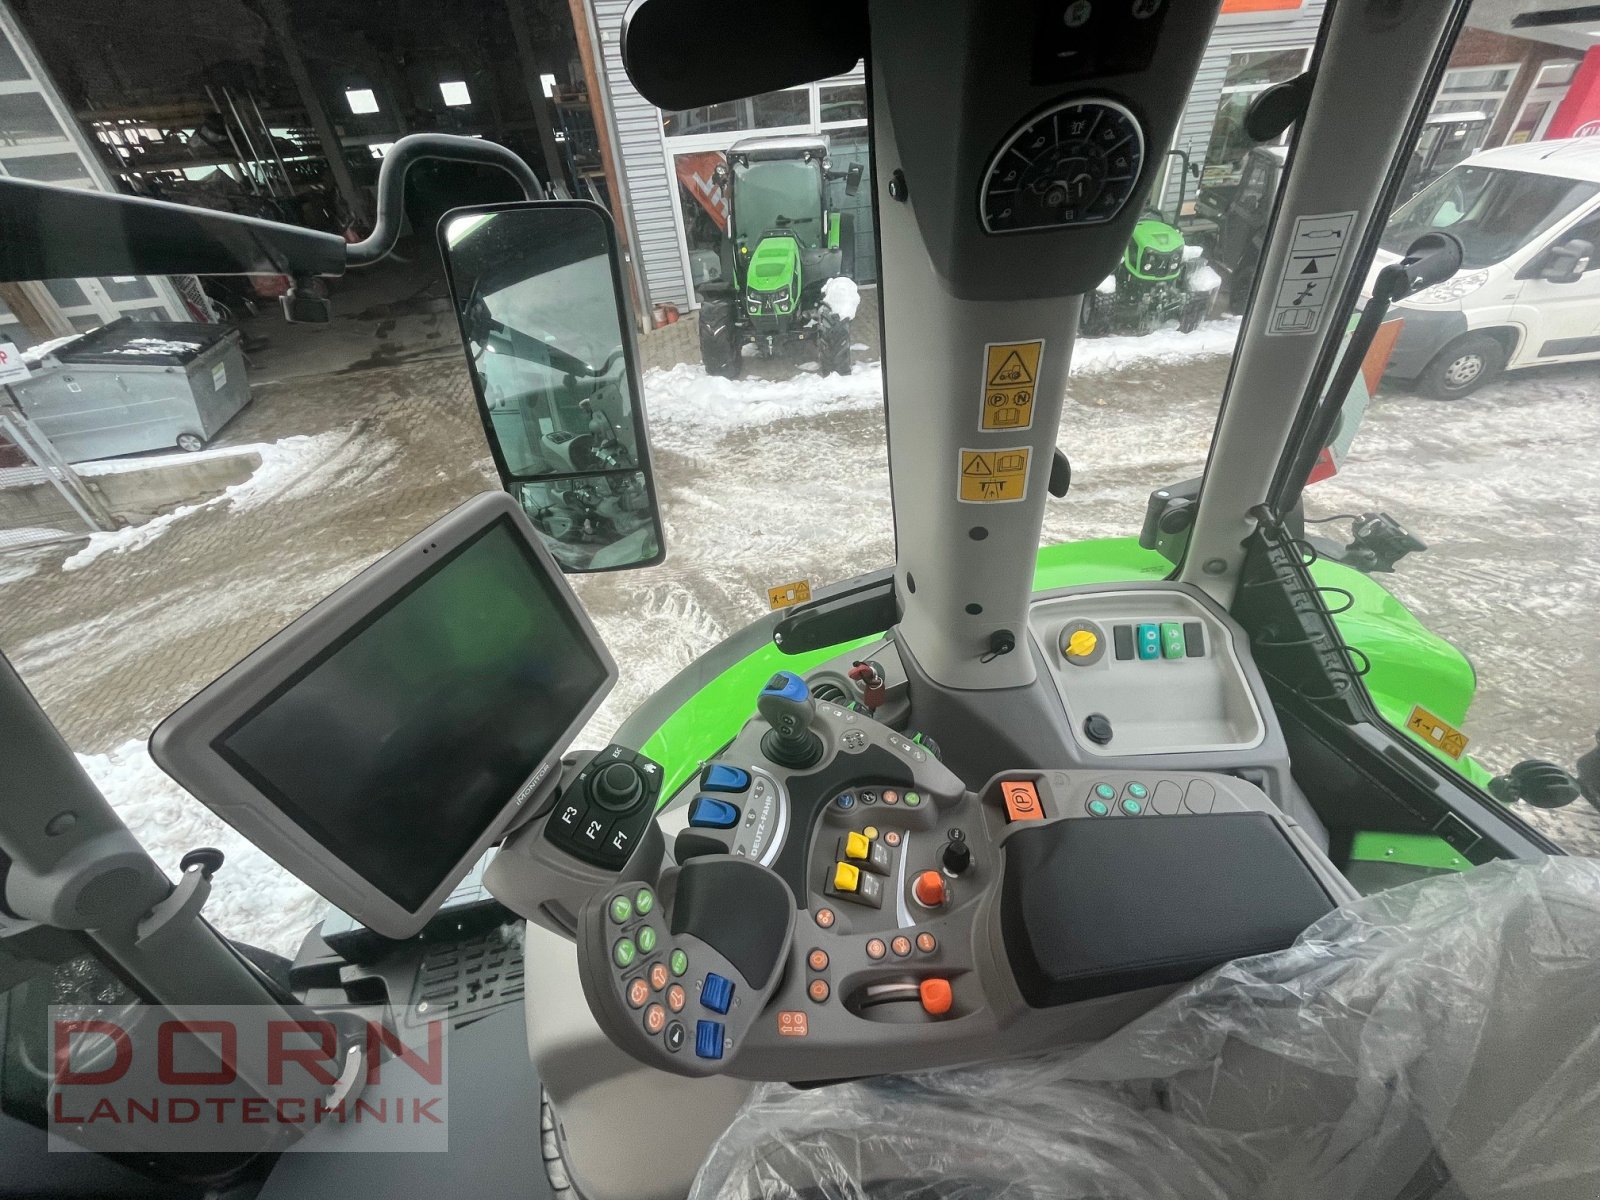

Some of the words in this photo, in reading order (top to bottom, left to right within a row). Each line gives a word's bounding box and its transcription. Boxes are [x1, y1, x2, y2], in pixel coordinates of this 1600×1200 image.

[612, 747, 623, 759] ESC
[561, 806, 578, 825] F3
[585, 820, 602, 840] F2
[750, 795, 773, 857] DEUTZ-FAHR
[612, 830, 628, 850] F1
